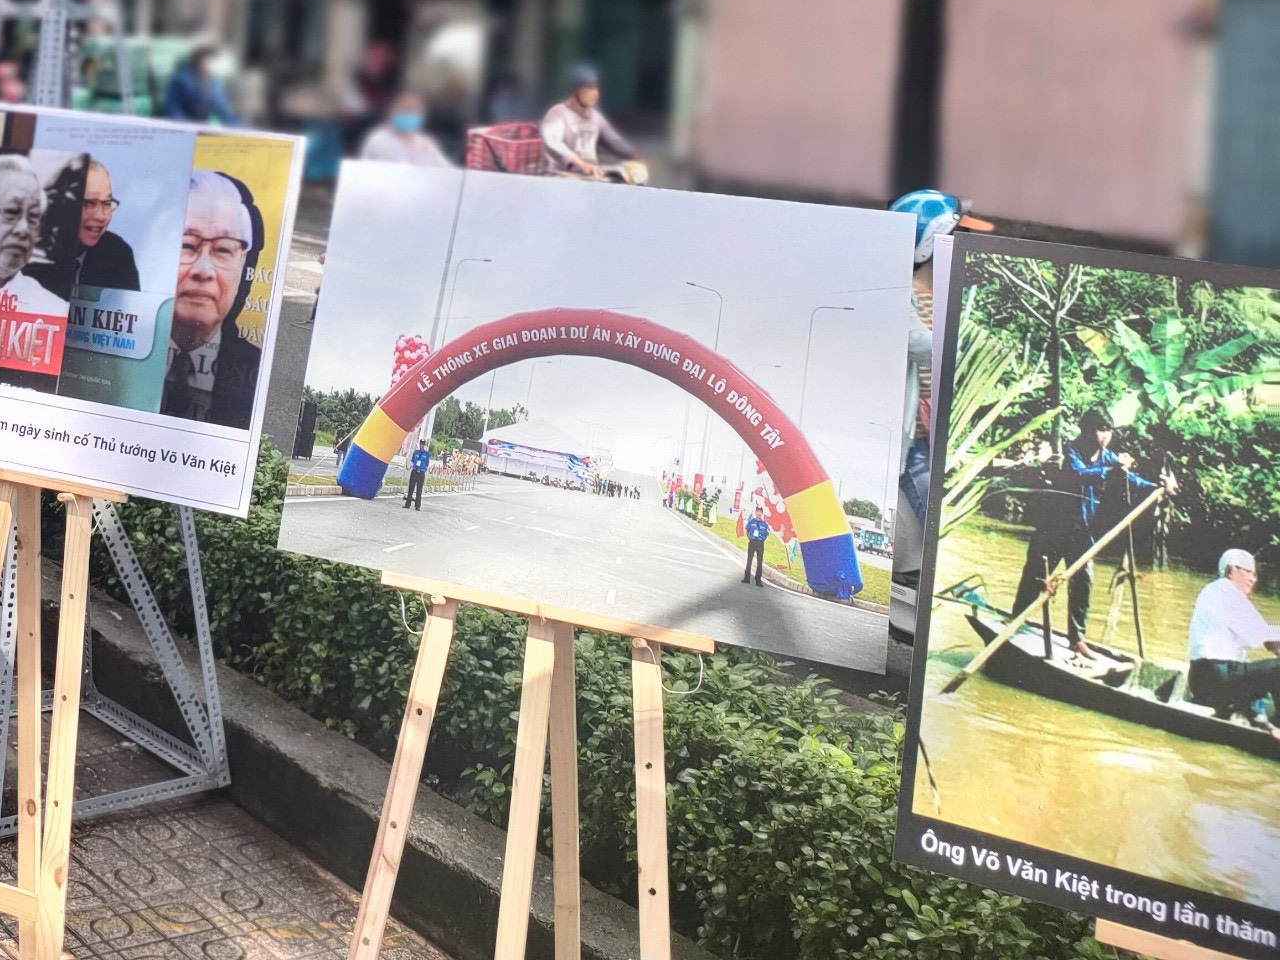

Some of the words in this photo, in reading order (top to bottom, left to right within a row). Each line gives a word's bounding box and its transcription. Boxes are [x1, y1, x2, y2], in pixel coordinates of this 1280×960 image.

[7, 318, 61, 367] KIỆT
[91, 308, 138, 335] KIỆT
[92, 331, 111, 348] VIỆT
[113, 336, 136, 351] NAM
[417, 370, 434, 393] LỄ
[433, 351, 474, 381] THÔNG
[473, 343, 491, 359] XE
[493, 332, 518, 351] GIAI
[521, 326, 557, 344] ĐOẠN
[560, 326, 567, 339] 1
[570, 325, 590, 343] DỰ
[592, 324, 611, 342] ÁN
[614, 331, 642, 350] XÂY
[644, 339, 680, 366] DỰNG
[681, 357, 707, 381] ĐẠI
[706, 373, 727, 396] LỘ
[726, 389, 763, 427] ĐÔNG
[759, 423, 785, 451] TÂY
[11, 421, 41, 439] ngày
[44, 428, 70, 443] sinh
[73, 433, 92, 447] cố
[93, 436, 117, 452] Thủ
[119, 441, 157, 463] tướng
[160, 448, 178, 464] Võ
[181, 452, 206, 470] Văn
[209, 458, 237, 478] Kiệt
[921, 828, 965, 866] Ông
[971, 845, 1000, 871] Võ
[1006, 855, 1048, 885] Văn
[1054, 868, 1100, 901] Kiệt
[1105, 883, 1168, 923] trong
[1173, 900, 1211, 930] lần
[1215, 913, 1277, 948] thăm
